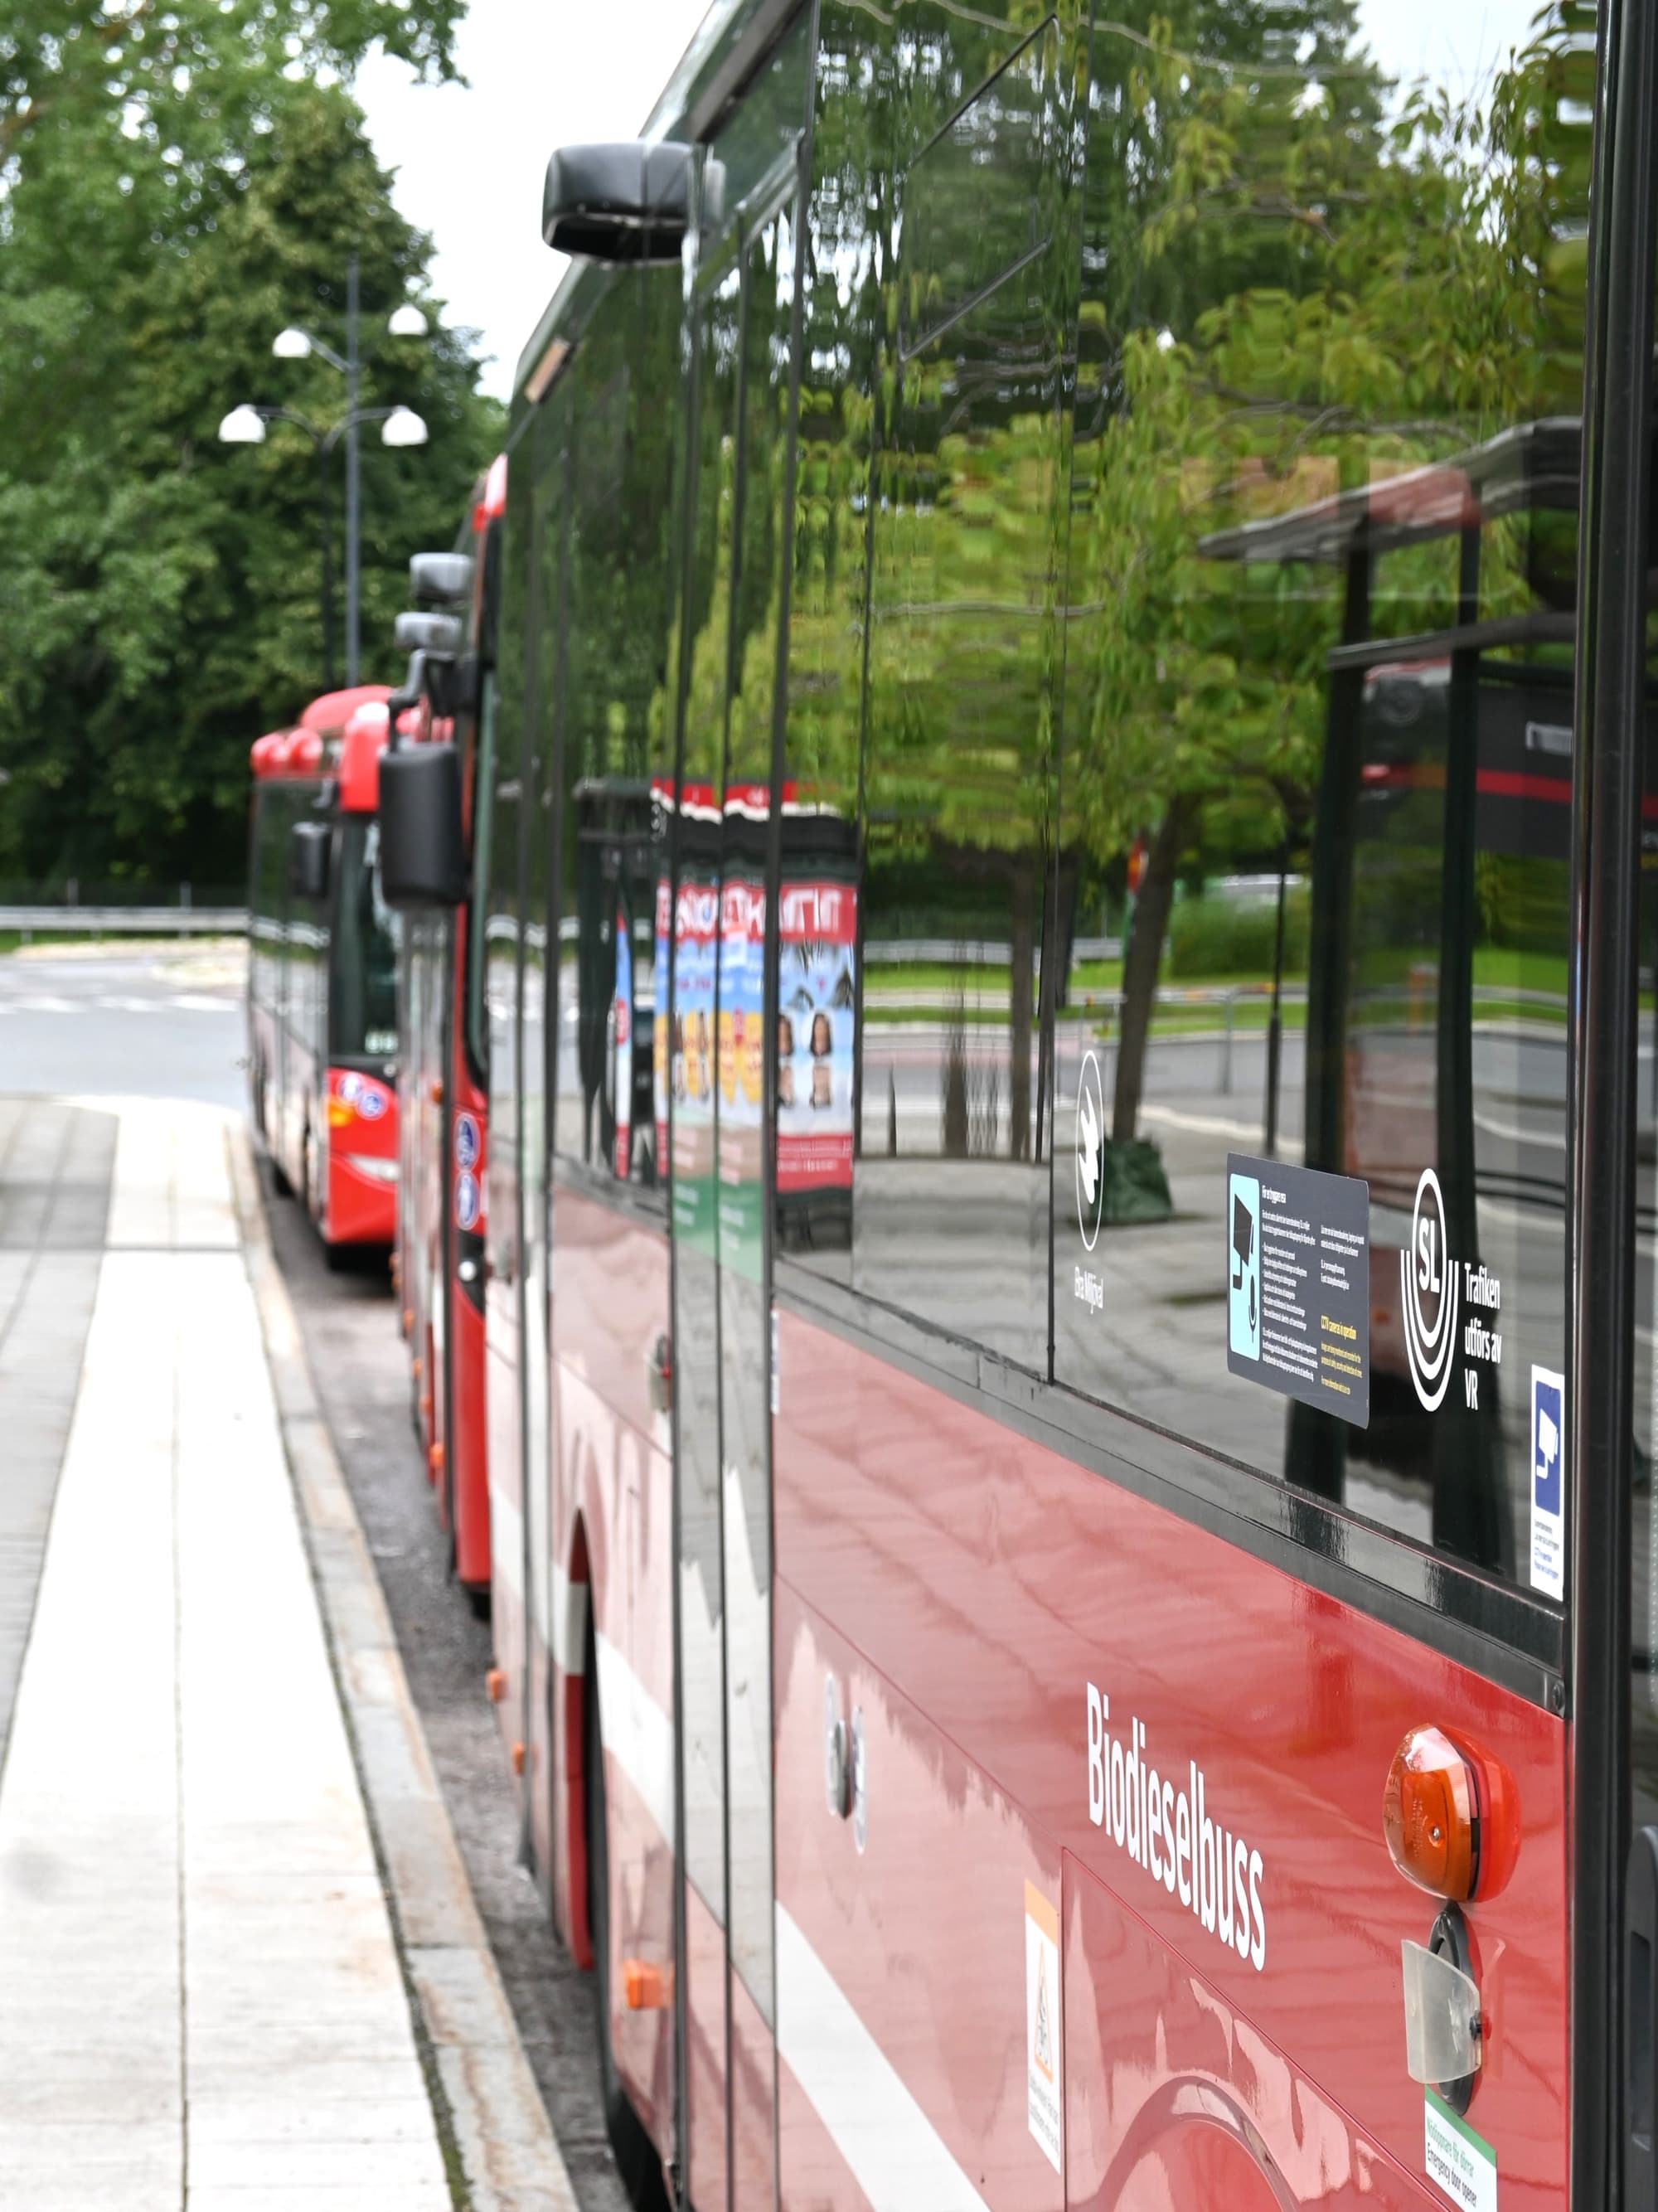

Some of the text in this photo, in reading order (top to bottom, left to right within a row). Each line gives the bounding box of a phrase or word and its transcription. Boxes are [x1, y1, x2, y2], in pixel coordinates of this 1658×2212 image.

[1418, 1218, 1439, 1293] SL
[1465, 1263, 1500, 1310] Trafiken
[1465, 1317, 1502, 1364] utförs av
[1465, 1368, 1478, 1410] VR
[1087, 1682, 1266, 1971] Biodieselbuss
[1428, 2142, 1476, 2209] Emergency door opener
